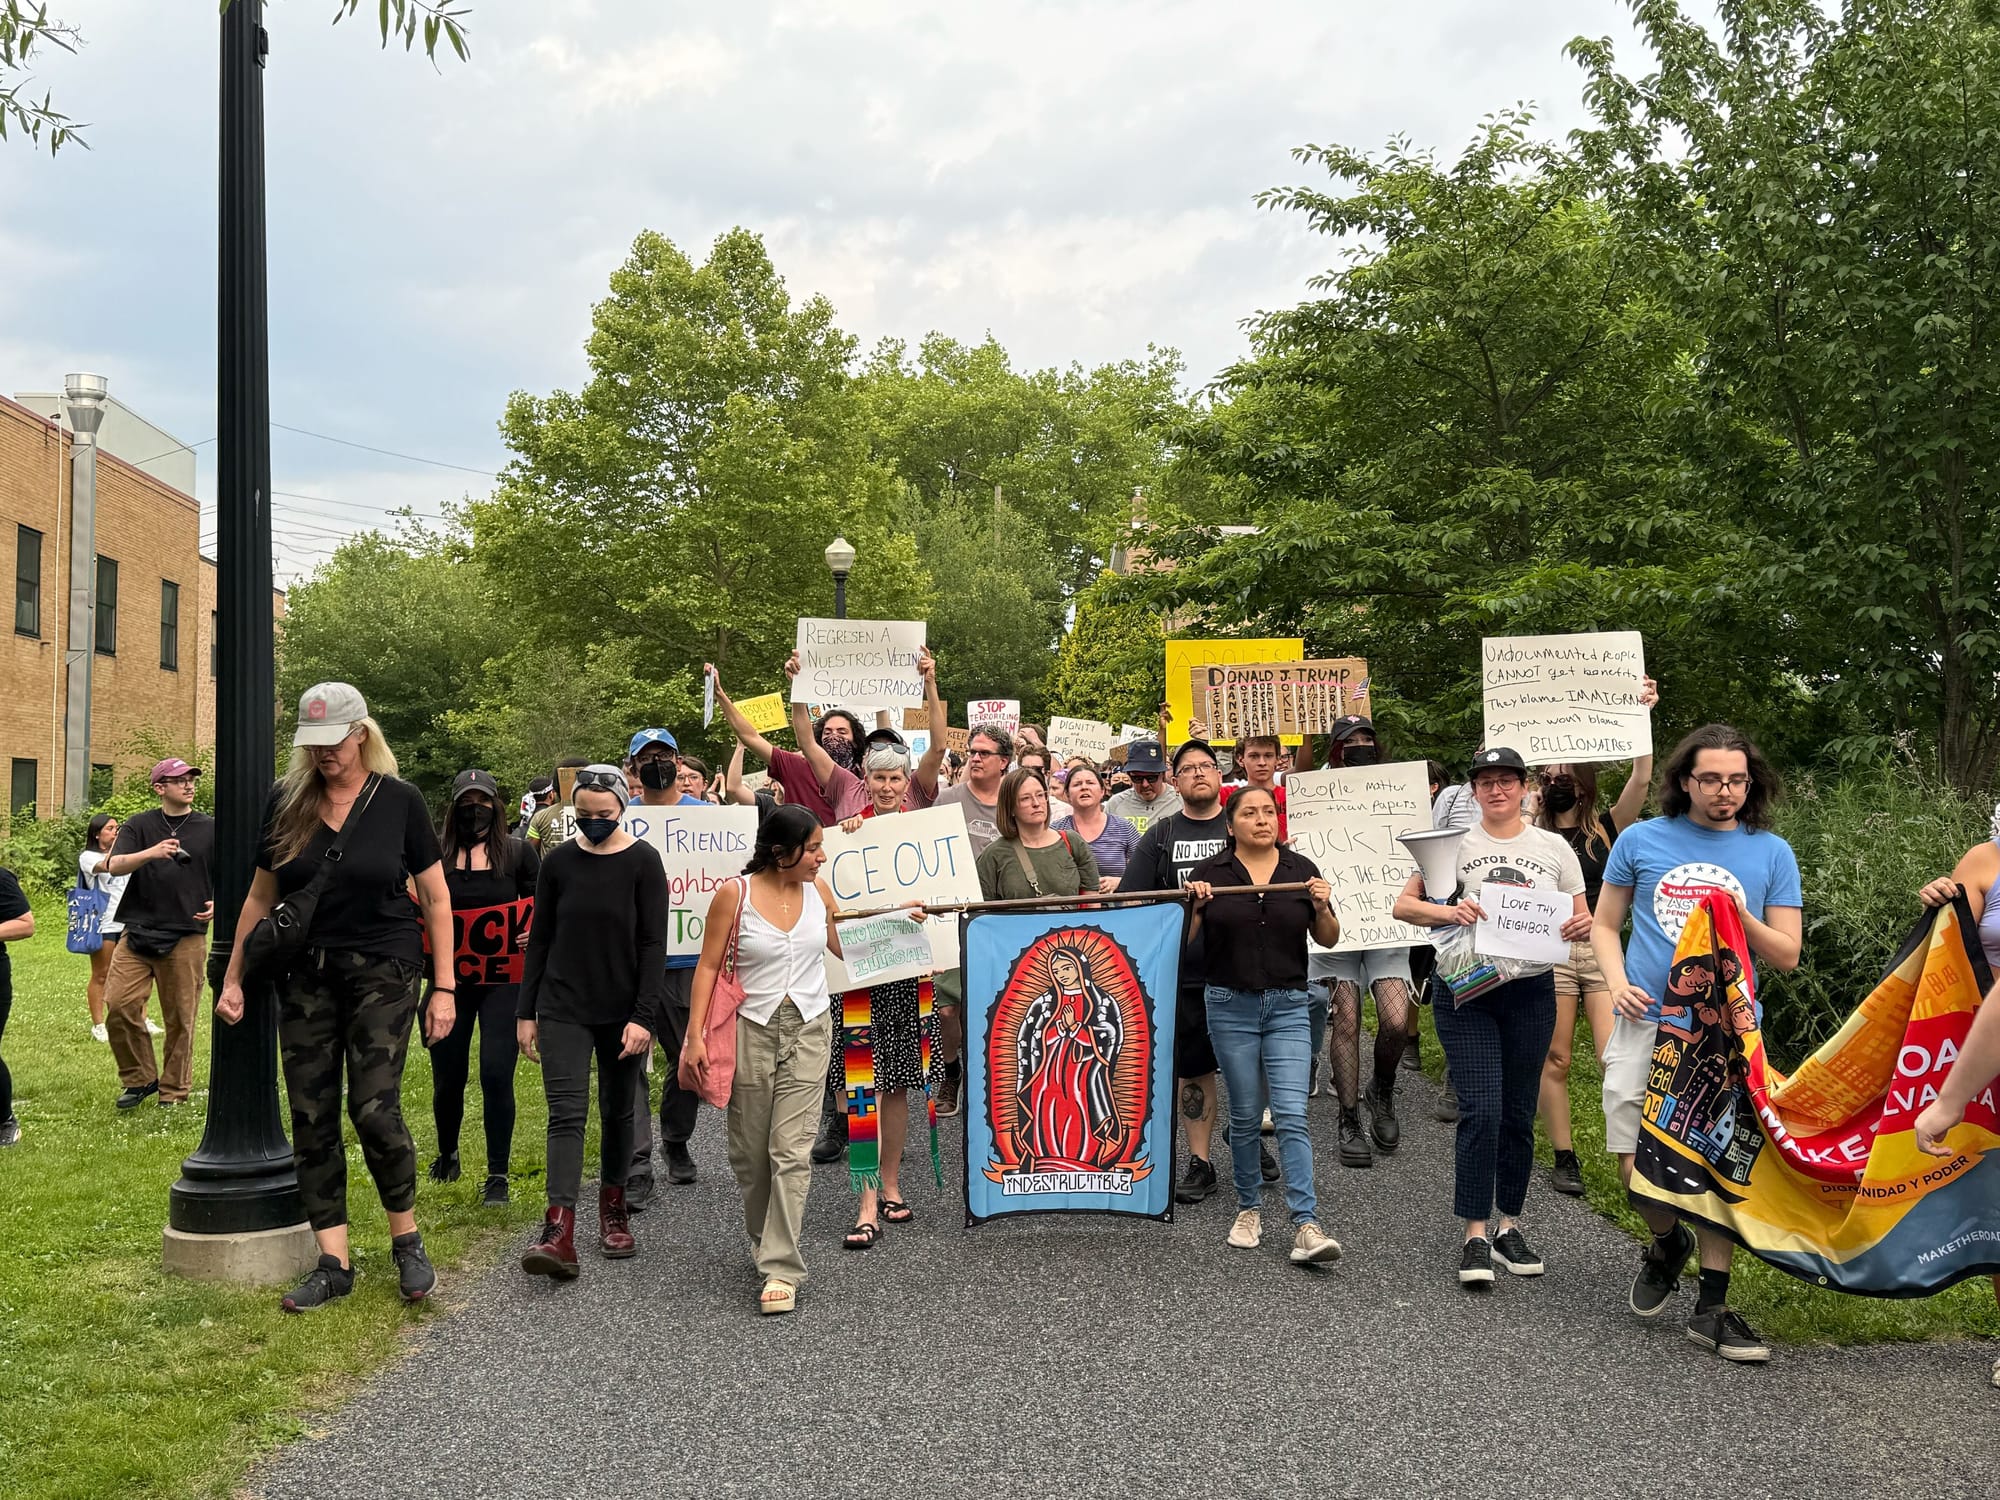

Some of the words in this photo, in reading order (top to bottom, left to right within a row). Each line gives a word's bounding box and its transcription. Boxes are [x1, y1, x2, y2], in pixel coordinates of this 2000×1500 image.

[806, 622, 874, 645] REGRESEN
[880, 627, 891, 641] A
[807, 649, 884, 669] NUESTROS
[1208, 667, 1274, 687] DONALD
[1296, 668, 1351, 684] TRUMP
[1486, 665, 1541, 685] CANNOT
[1547, 666, 1575, 681] get
[977, 701, 1006, 713] STOP
[1519, 693, 1564, 704] blame
[947, 730, 967, 741] KEEP
[1060, 720, 1096, 733] DIGNITY
[1054, 735, 1069, 746] DUE
[1074, 738, 1106, 751] PROCESS
[1530, 734, 1633, 752] BILLIONAIRES
[665, 817, 747, 854] FRIENDS
[1175, 842, 1191, 860] NO
[831, 845, 886, 900] CE
[894, 835, 960, 887] OUT
[1461, 855, 1508, 875] MOTOR
[1515, 857, 1547, 876] CITY
[1322, 867, 1349, 888] CK
[1350, 864, 1380, 885] THE
[1351, 890, 1382, 913] THE
[1667, 887, 1693, 896] MAKE
[1501, 893, 1532, 912] LOVE
[1536, 904, 1558, 917] THY
[1666, 909, 1689, 918] PENN
[1667, 897, 1698, 910] ACT
[453, 903, 534, 957] CK
[1360, 924, 1408, 943] DONALD
[1497, 914, 1551, 936] NEIGHBOR
[455, 953, 511, 984] CE
[852, 946, 930, 978] ILLEGAL
[1892, 1037, 1960, 1079] OA
[1857, 1183, 1906, 1199] NIDAD
[1909, 1178, 1919, 1190] Y
[1923, 1155, 1970, 1185] PODER
